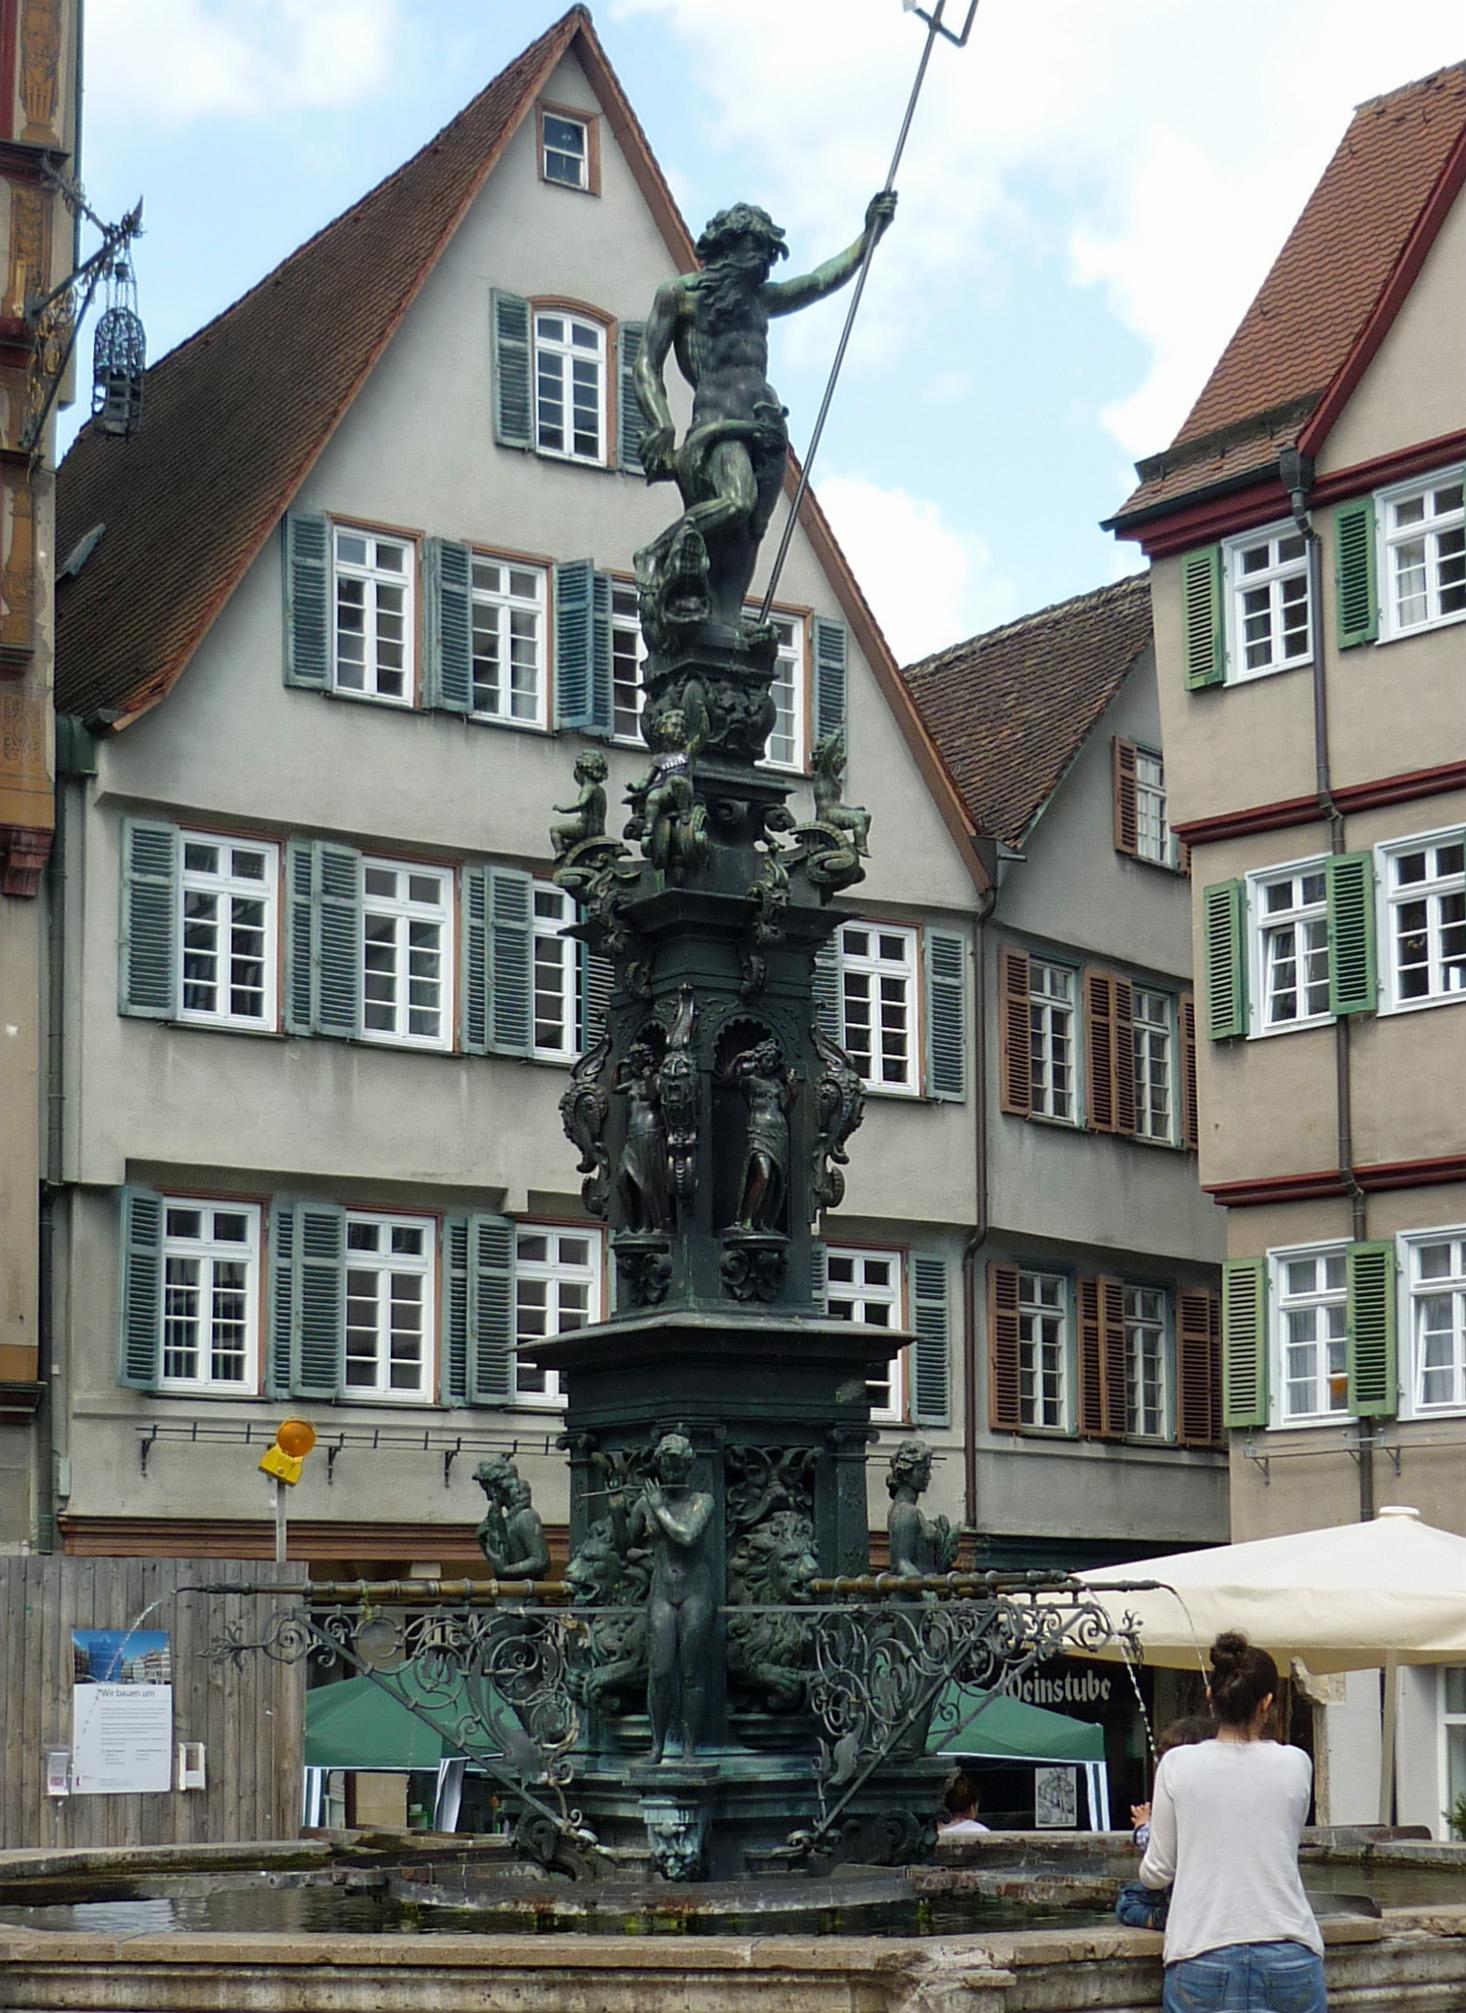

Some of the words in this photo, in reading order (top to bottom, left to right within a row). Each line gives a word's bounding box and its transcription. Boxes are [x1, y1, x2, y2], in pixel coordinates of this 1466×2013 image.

[101, 1688, 114, 1697] Wir
[116, 1688, 141, 1697] bauen
[142, 1690, 156, 1698] um
